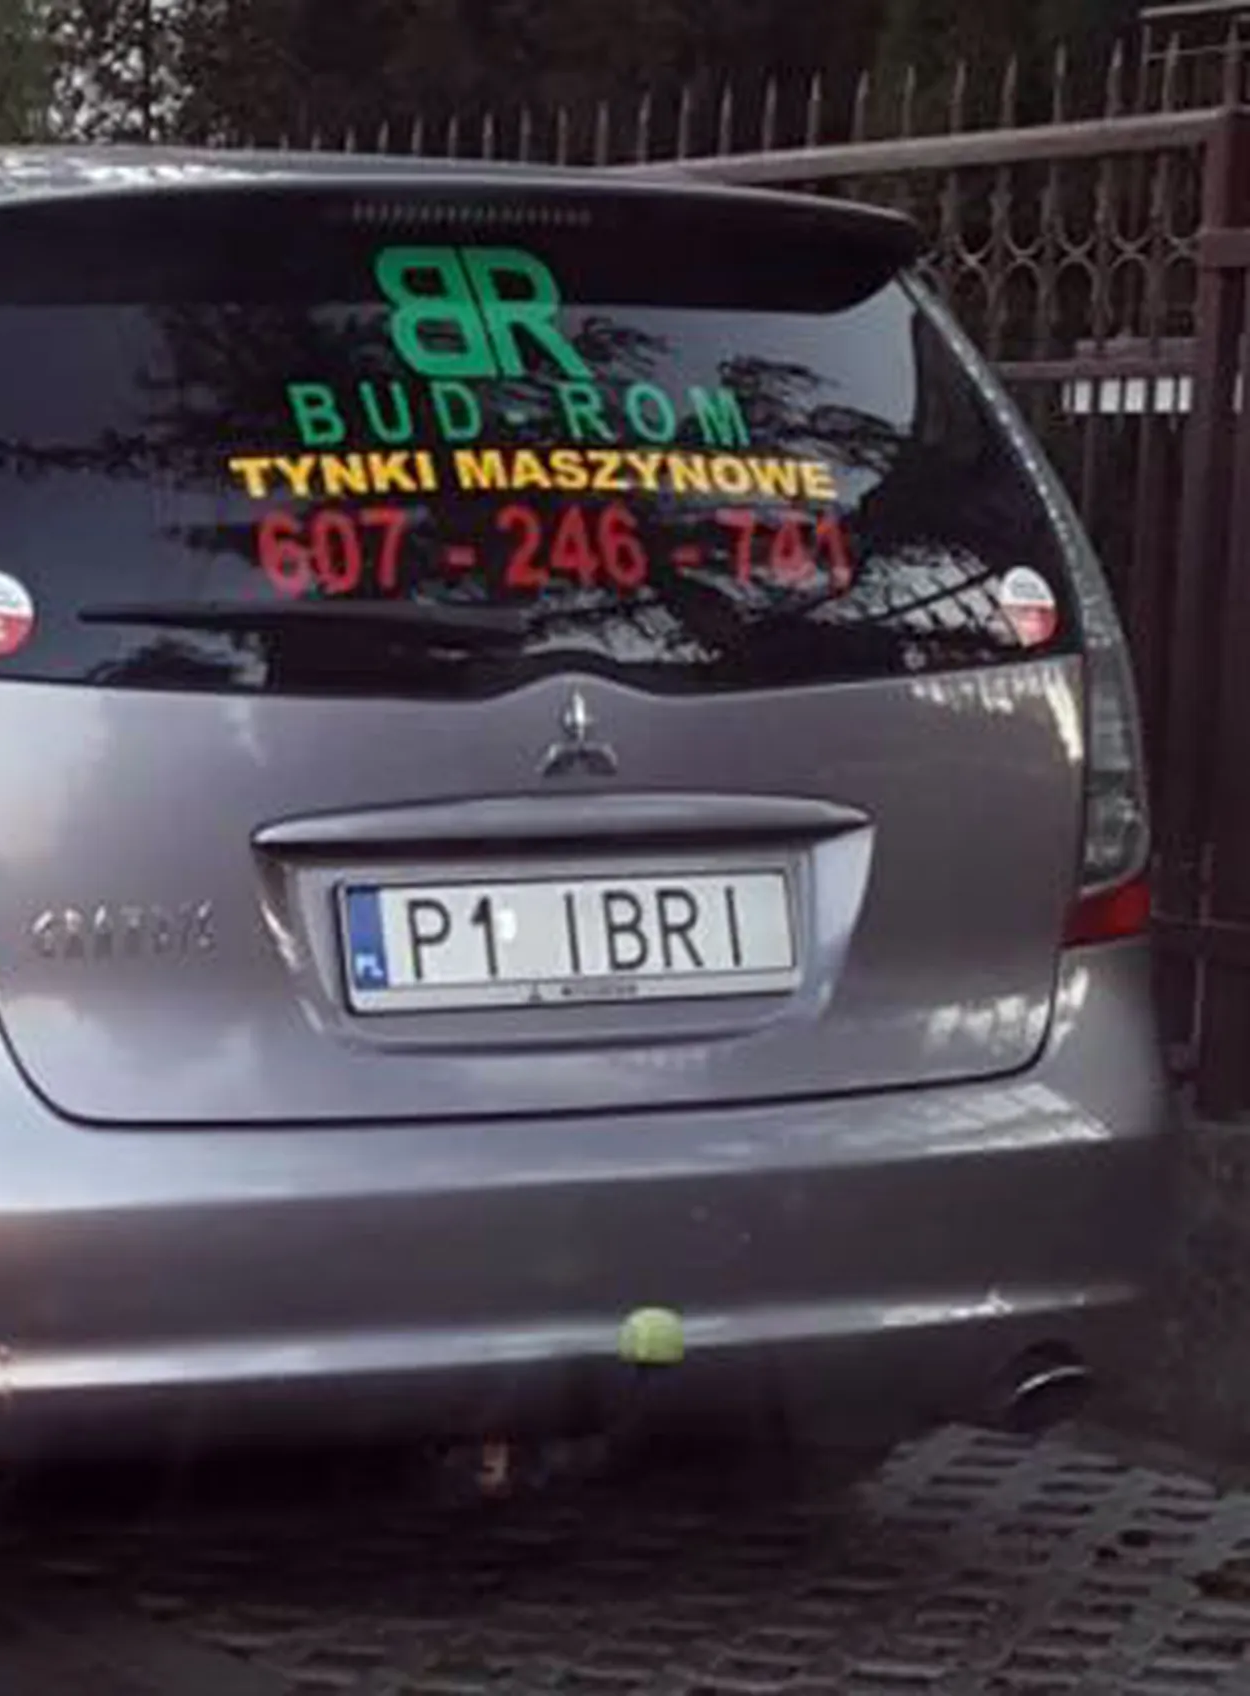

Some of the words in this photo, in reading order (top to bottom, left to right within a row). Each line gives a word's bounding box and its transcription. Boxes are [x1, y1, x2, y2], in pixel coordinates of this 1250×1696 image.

[229, 452, 436, 497] TYNKI
[454, 450, 838, 500] MASZYNOWE
[258, 510, 410, 594] 607
[496, 506, 646, 588] 246
[407, 896, 498, 979] P1
